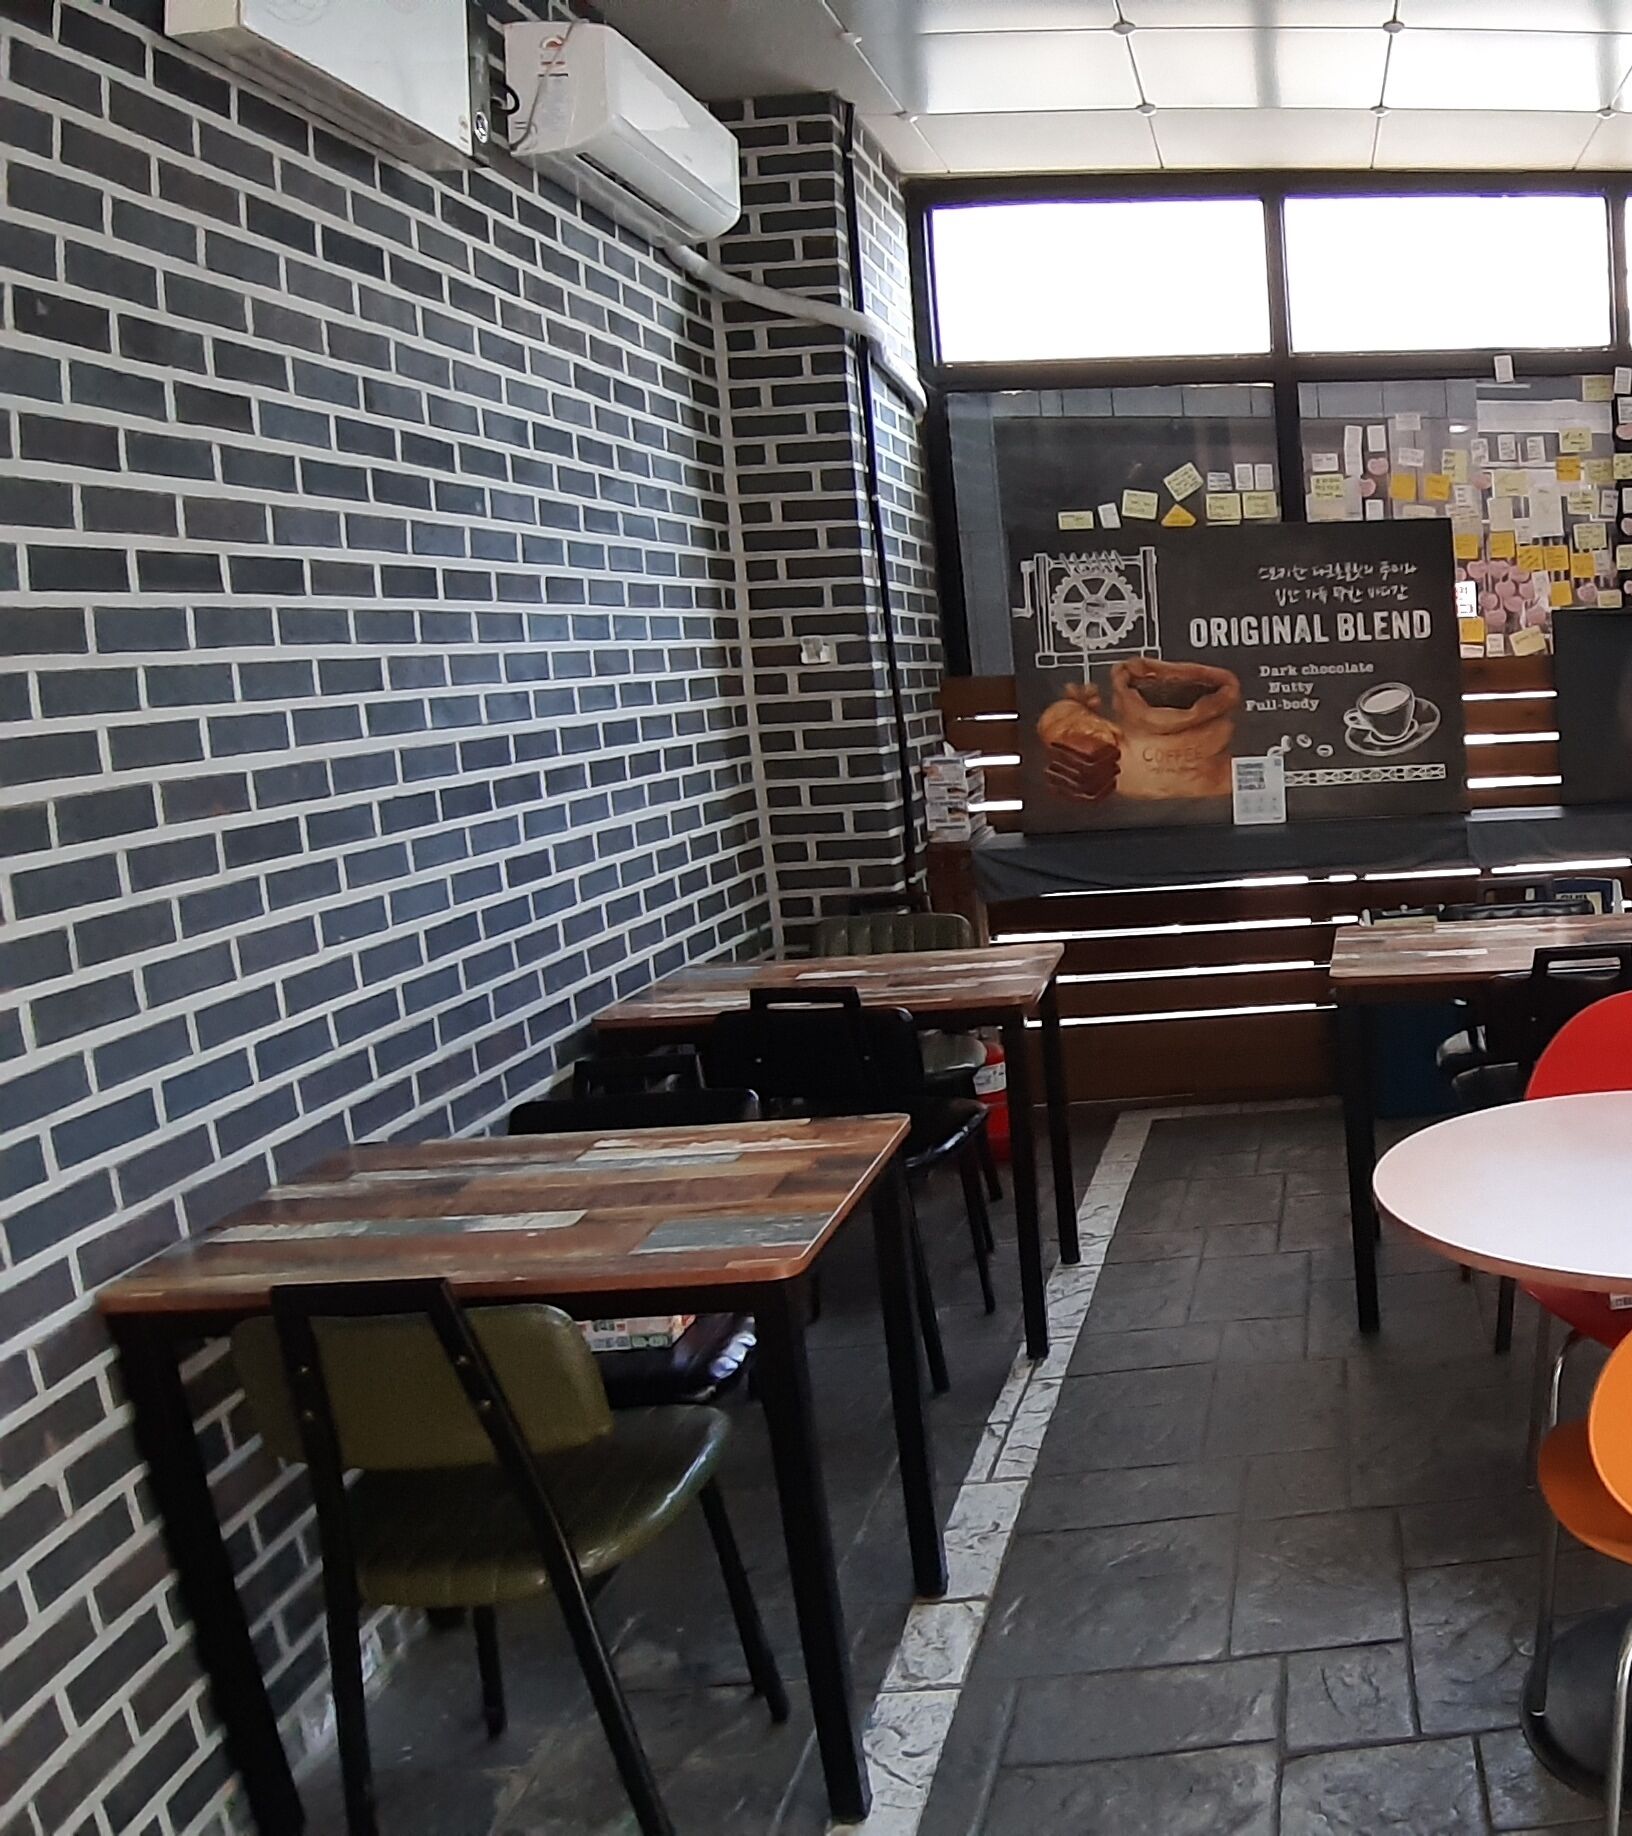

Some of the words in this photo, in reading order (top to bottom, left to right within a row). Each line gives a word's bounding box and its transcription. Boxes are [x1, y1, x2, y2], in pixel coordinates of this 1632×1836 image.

[1189, 613, 1330, 648] ORIGINAL
[1336, 609, 1433, 643] BLEND
[1259, 664, 1298, 678] Dark
[1301, 661, 1375, 676] chocolate
[1268, 681, 1314, 695] Nutty
[1245, 698, 1320, 713] Full-body
